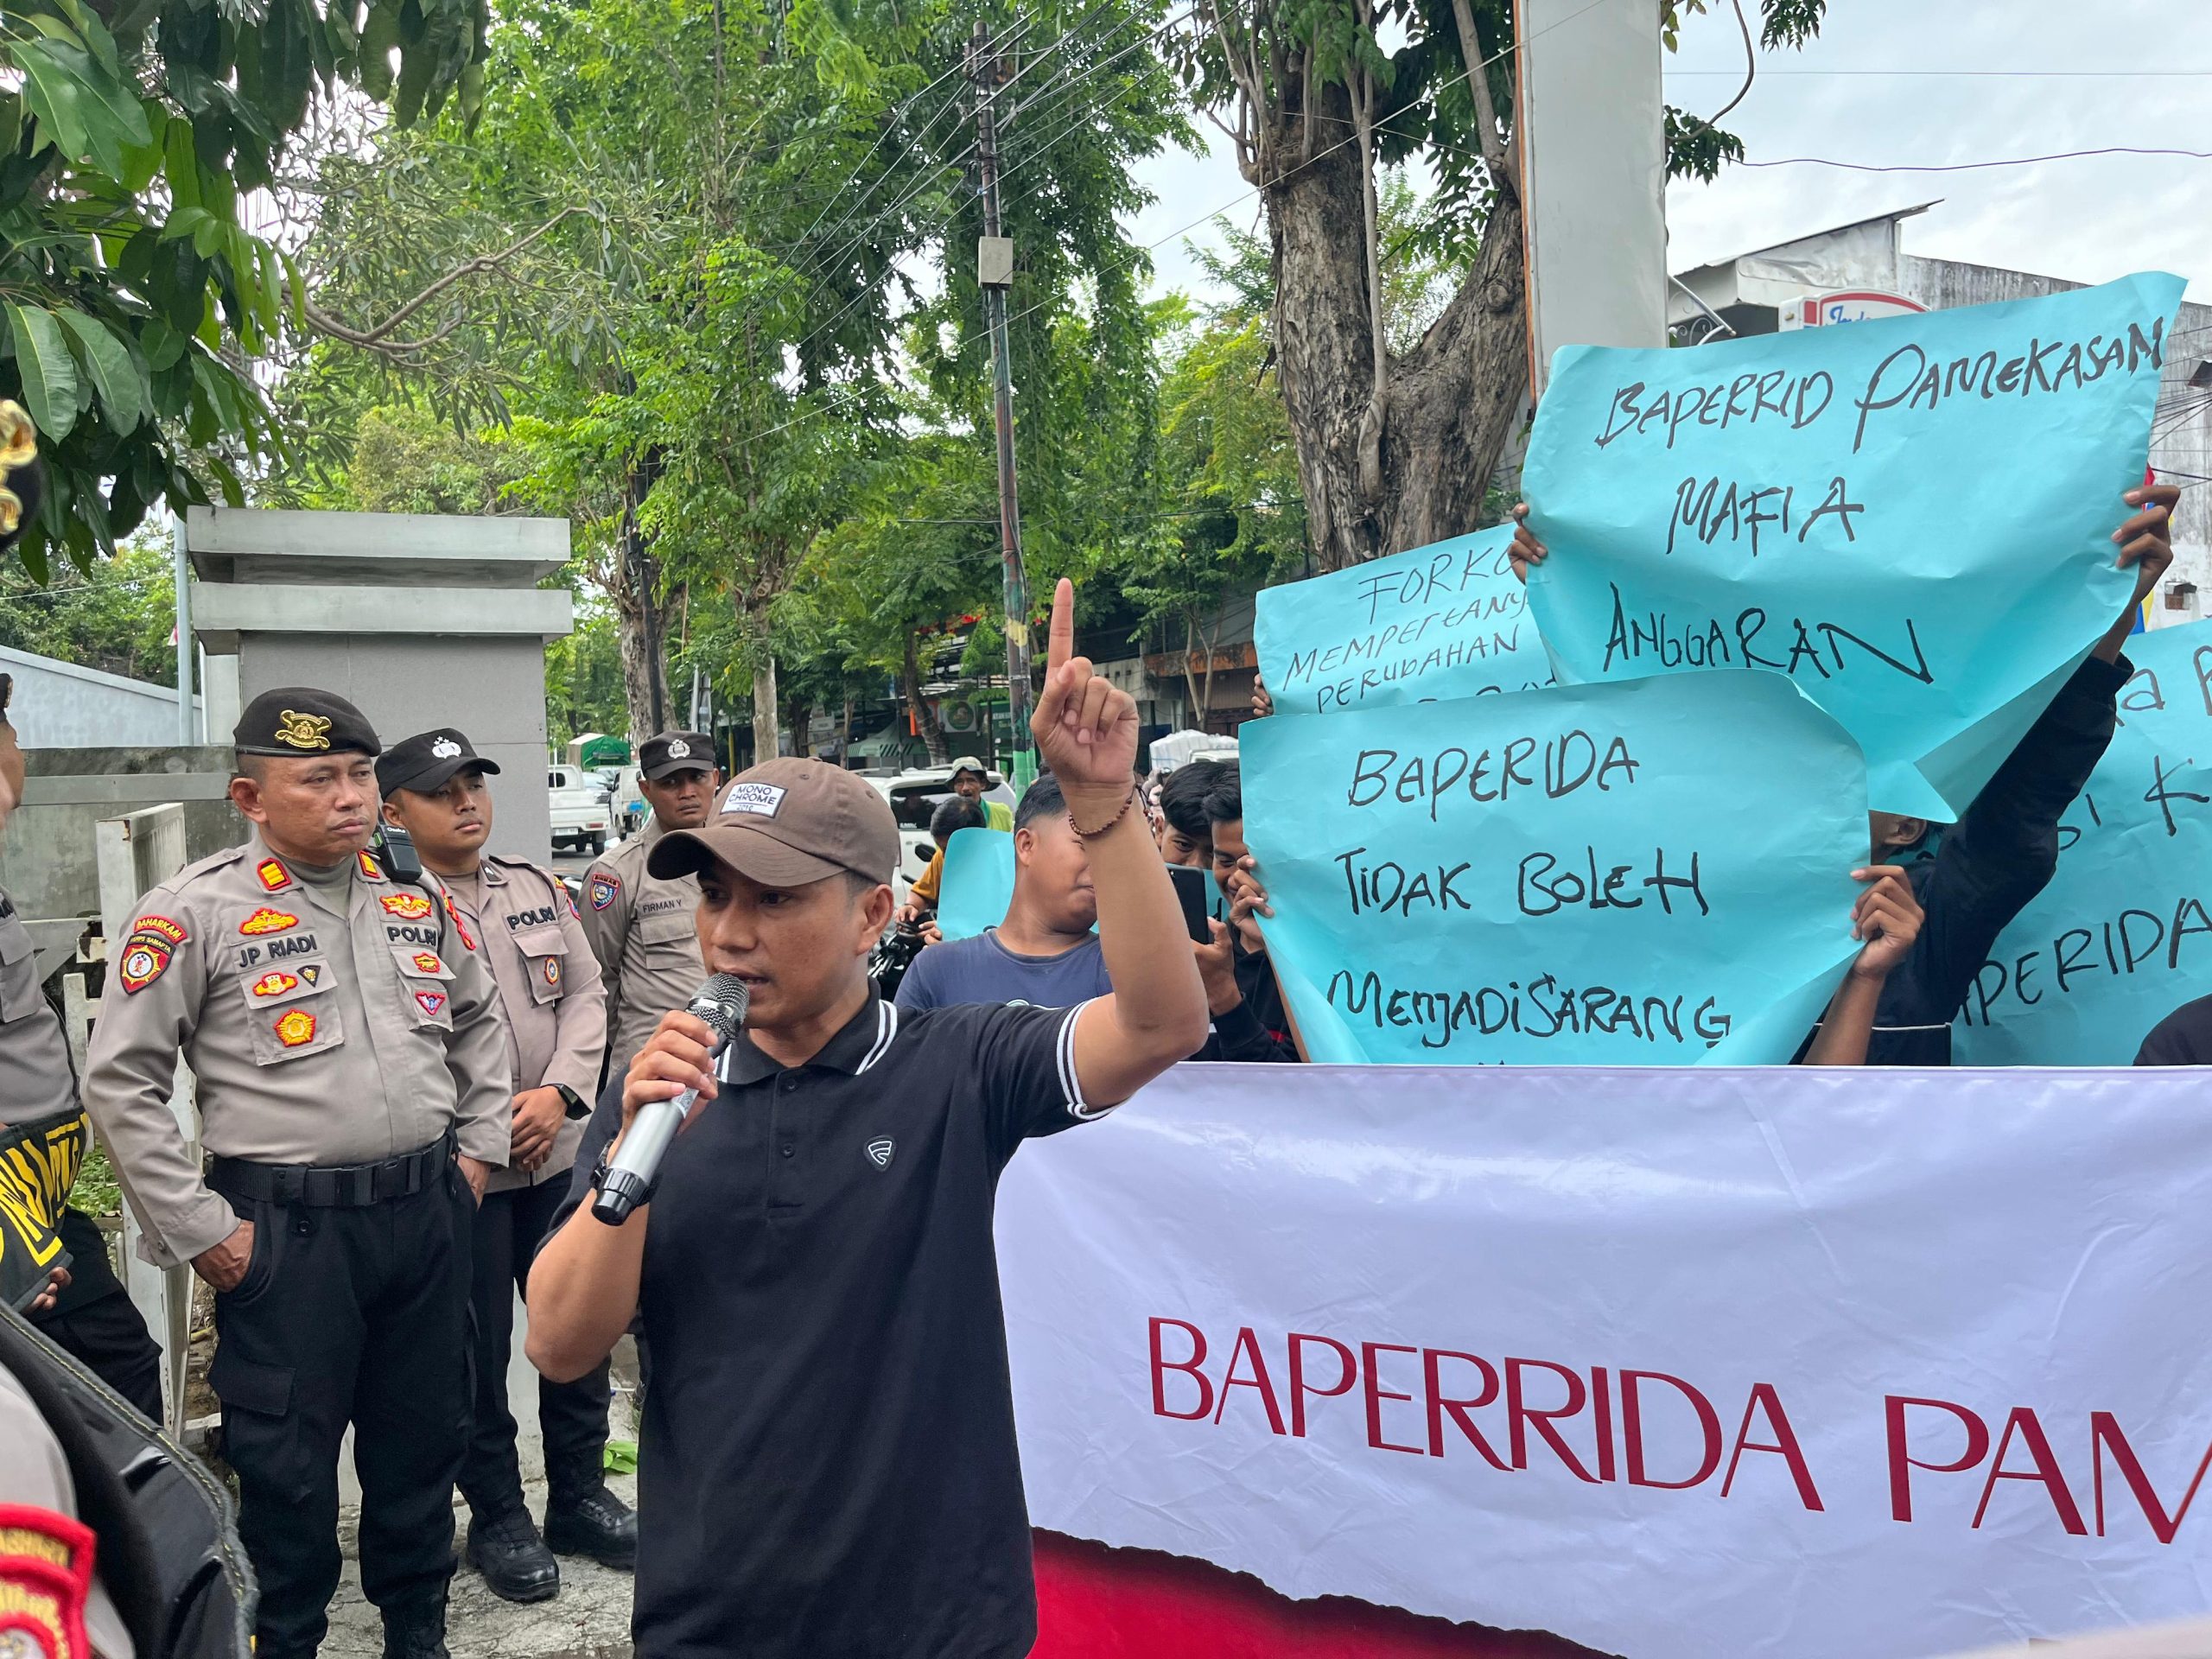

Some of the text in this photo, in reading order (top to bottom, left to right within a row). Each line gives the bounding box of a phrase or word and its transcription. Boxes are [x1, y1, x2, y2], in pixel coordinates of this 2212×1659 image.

[1853, 315, 2164, 455] PAMEKASAN
[1665, 475, 1865, 557] MAFIA
[1603, 581, 1935, 684] ANGGARAN
[737, 785, 772, 796] MONO
[1348, 729, 1640, 823] BAPERIDA
[728, 793, 777, 805] CHROME
[506, 906, 556, 931] POLRI
[643, 901, 675, 912] FIRMAN
[239, 934, 318, 969] JP RIADI
[386, 925, 437, 947] POLRI
[1148, 1316, 1825, 1512] BAPERRIDA
